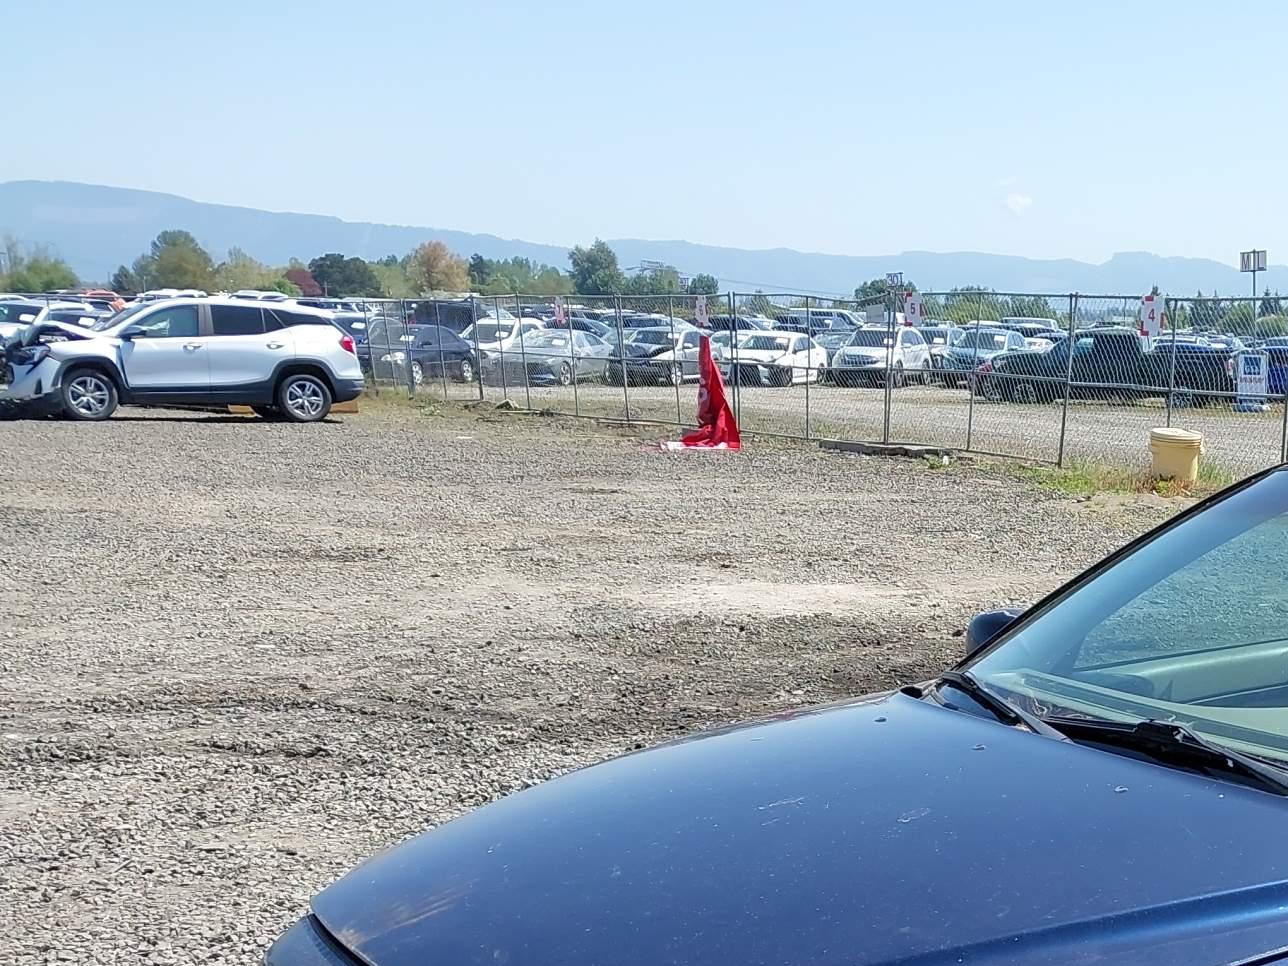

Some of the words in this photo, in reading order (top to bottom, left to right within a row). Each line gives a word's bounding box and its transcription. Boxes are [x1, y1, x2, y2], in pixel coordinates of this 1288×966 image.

[1241, 252, 1250, 270] M
[1257, 251, 1265, 270] L
[910, 303, 916, 315] 5
[1148, 308, 1156, 322] 4
